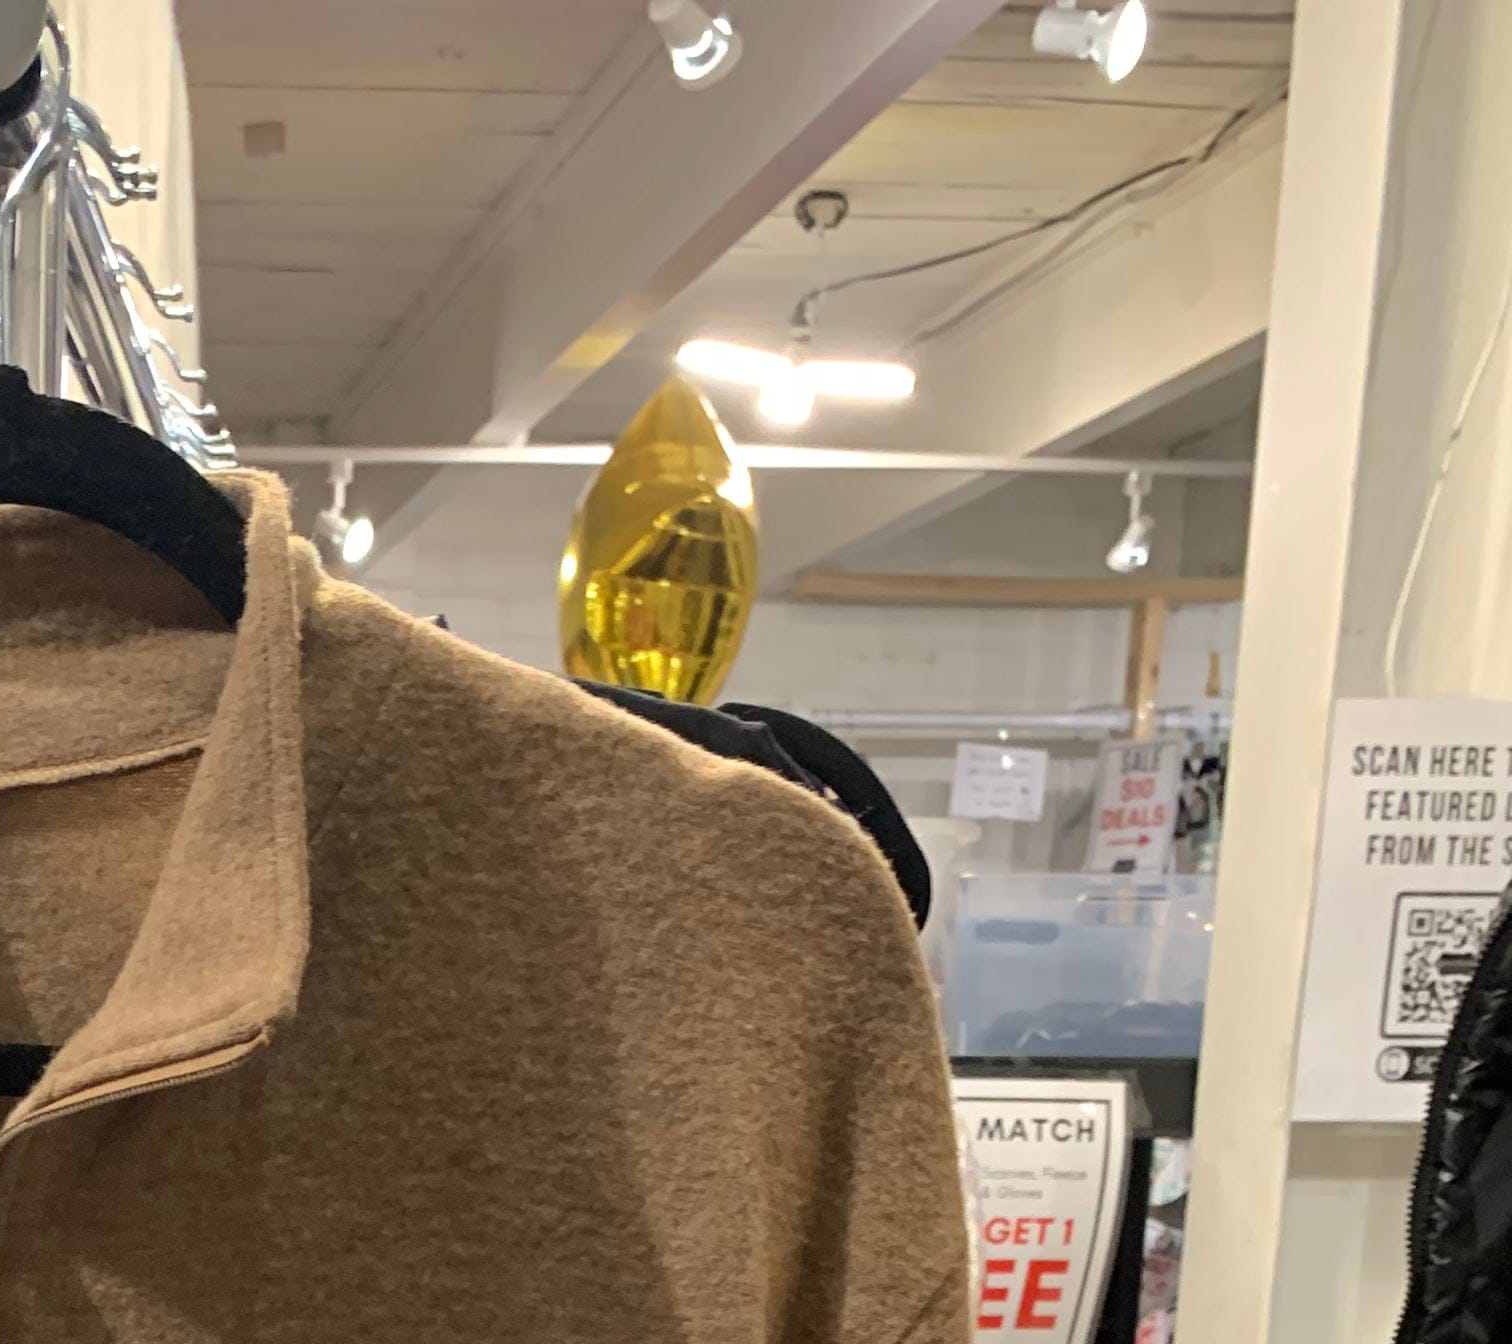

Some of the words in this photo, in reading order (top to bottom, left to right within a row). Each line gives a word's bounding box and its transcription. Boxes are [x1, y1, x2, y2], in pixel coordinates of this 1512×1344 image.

[1352, 746, 1420, 776] SCAN
[1430, 746, 1497, 777] HERE
[1100, 805, 1166, 831] DEALS
[1365, 790, 1497, 821] FEATURED
[1366, 835, 1436, 866] FROM
[1447, 835, 1494, 866] THE
[976, 1117, 1095, 1142] MATCH
[984, 1217, 1054, 1246] GET
[1063, 1218, 1075, 1246] 1
